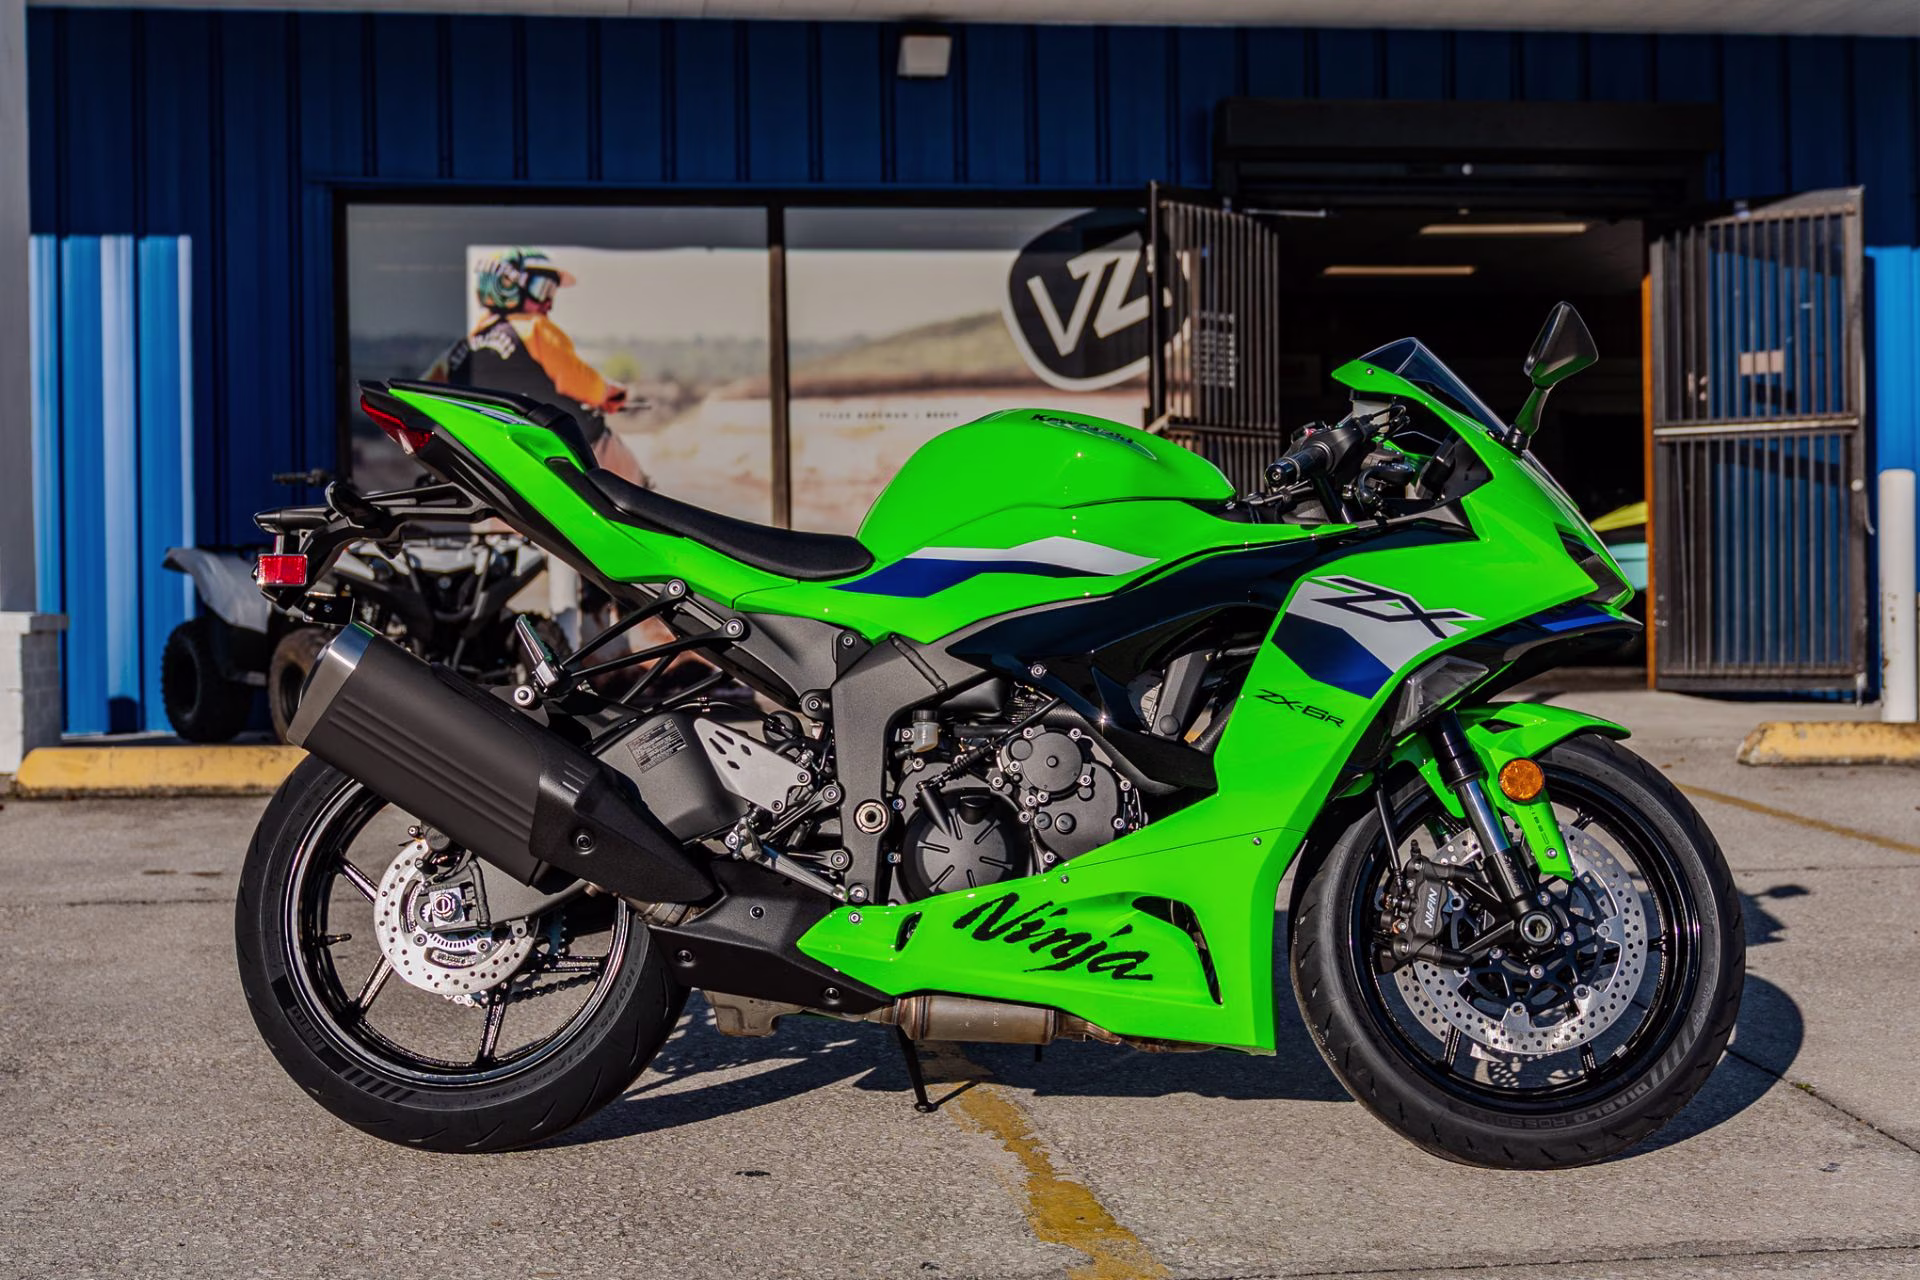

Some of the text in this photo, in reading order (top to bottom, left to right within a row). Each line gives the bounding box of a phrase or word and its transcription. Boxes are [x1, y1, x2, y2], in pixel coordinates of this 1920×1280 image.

[1254, 688, 1345, 728] ZX-6R
[953, 892, 1153, 981] Ninja
[1573, 1083, 1650, 1123] DIABLO
